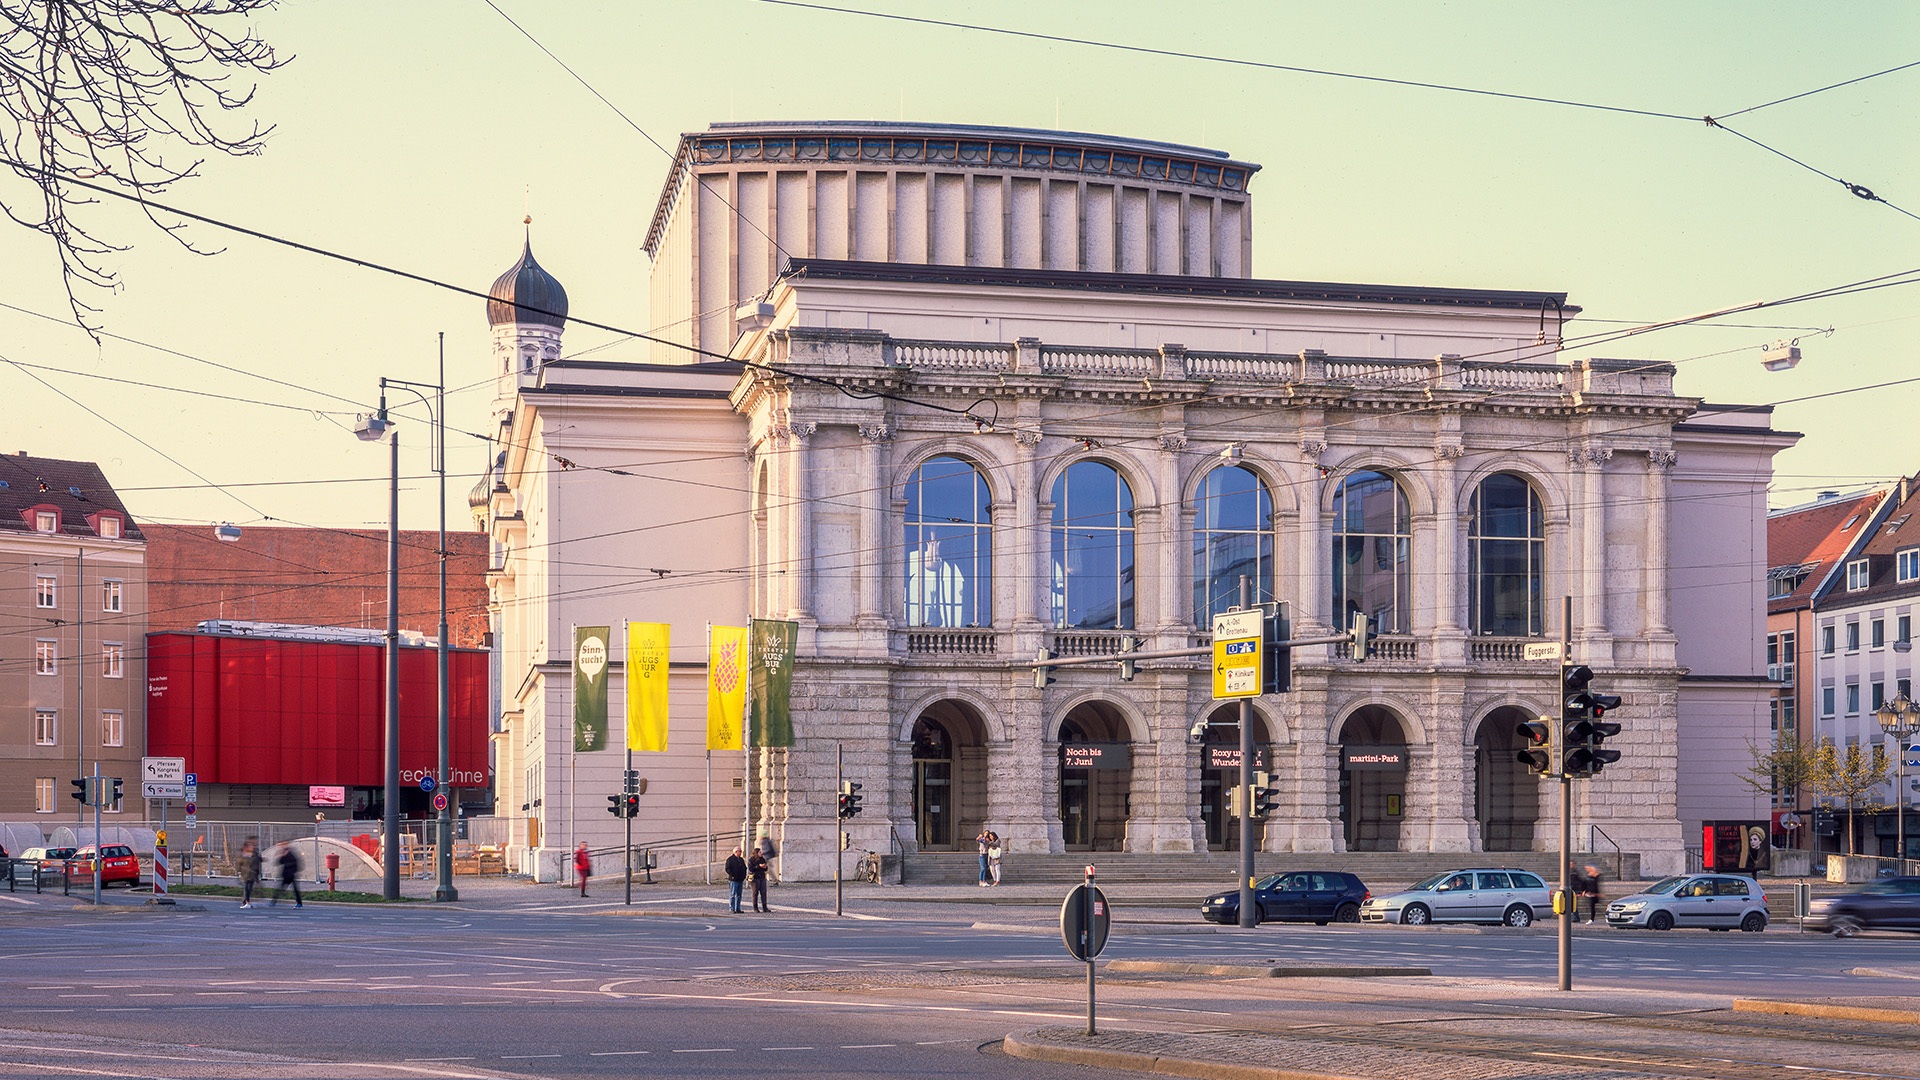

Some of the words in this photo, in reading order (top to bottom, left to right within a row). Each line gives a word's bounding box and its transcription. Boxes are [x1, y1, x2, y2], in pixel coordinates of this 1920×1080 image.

[582, 645, 603, 654] Sinn-
[1528, 647, 1556, 657] Fuggerstr.
[581, 656, 603, 664] sucht
[762, 653, 783, 661] AUGS
[770, 667, 777, 675] G
[1066, 748, 1088, 756] Noch
[1089, 748, 1102, 756] bis
[1212, 749, 1232, 758] Roxy
[1066, 758, 1074, 766] 7.
[1074, 758, 1093, 766] Juni
